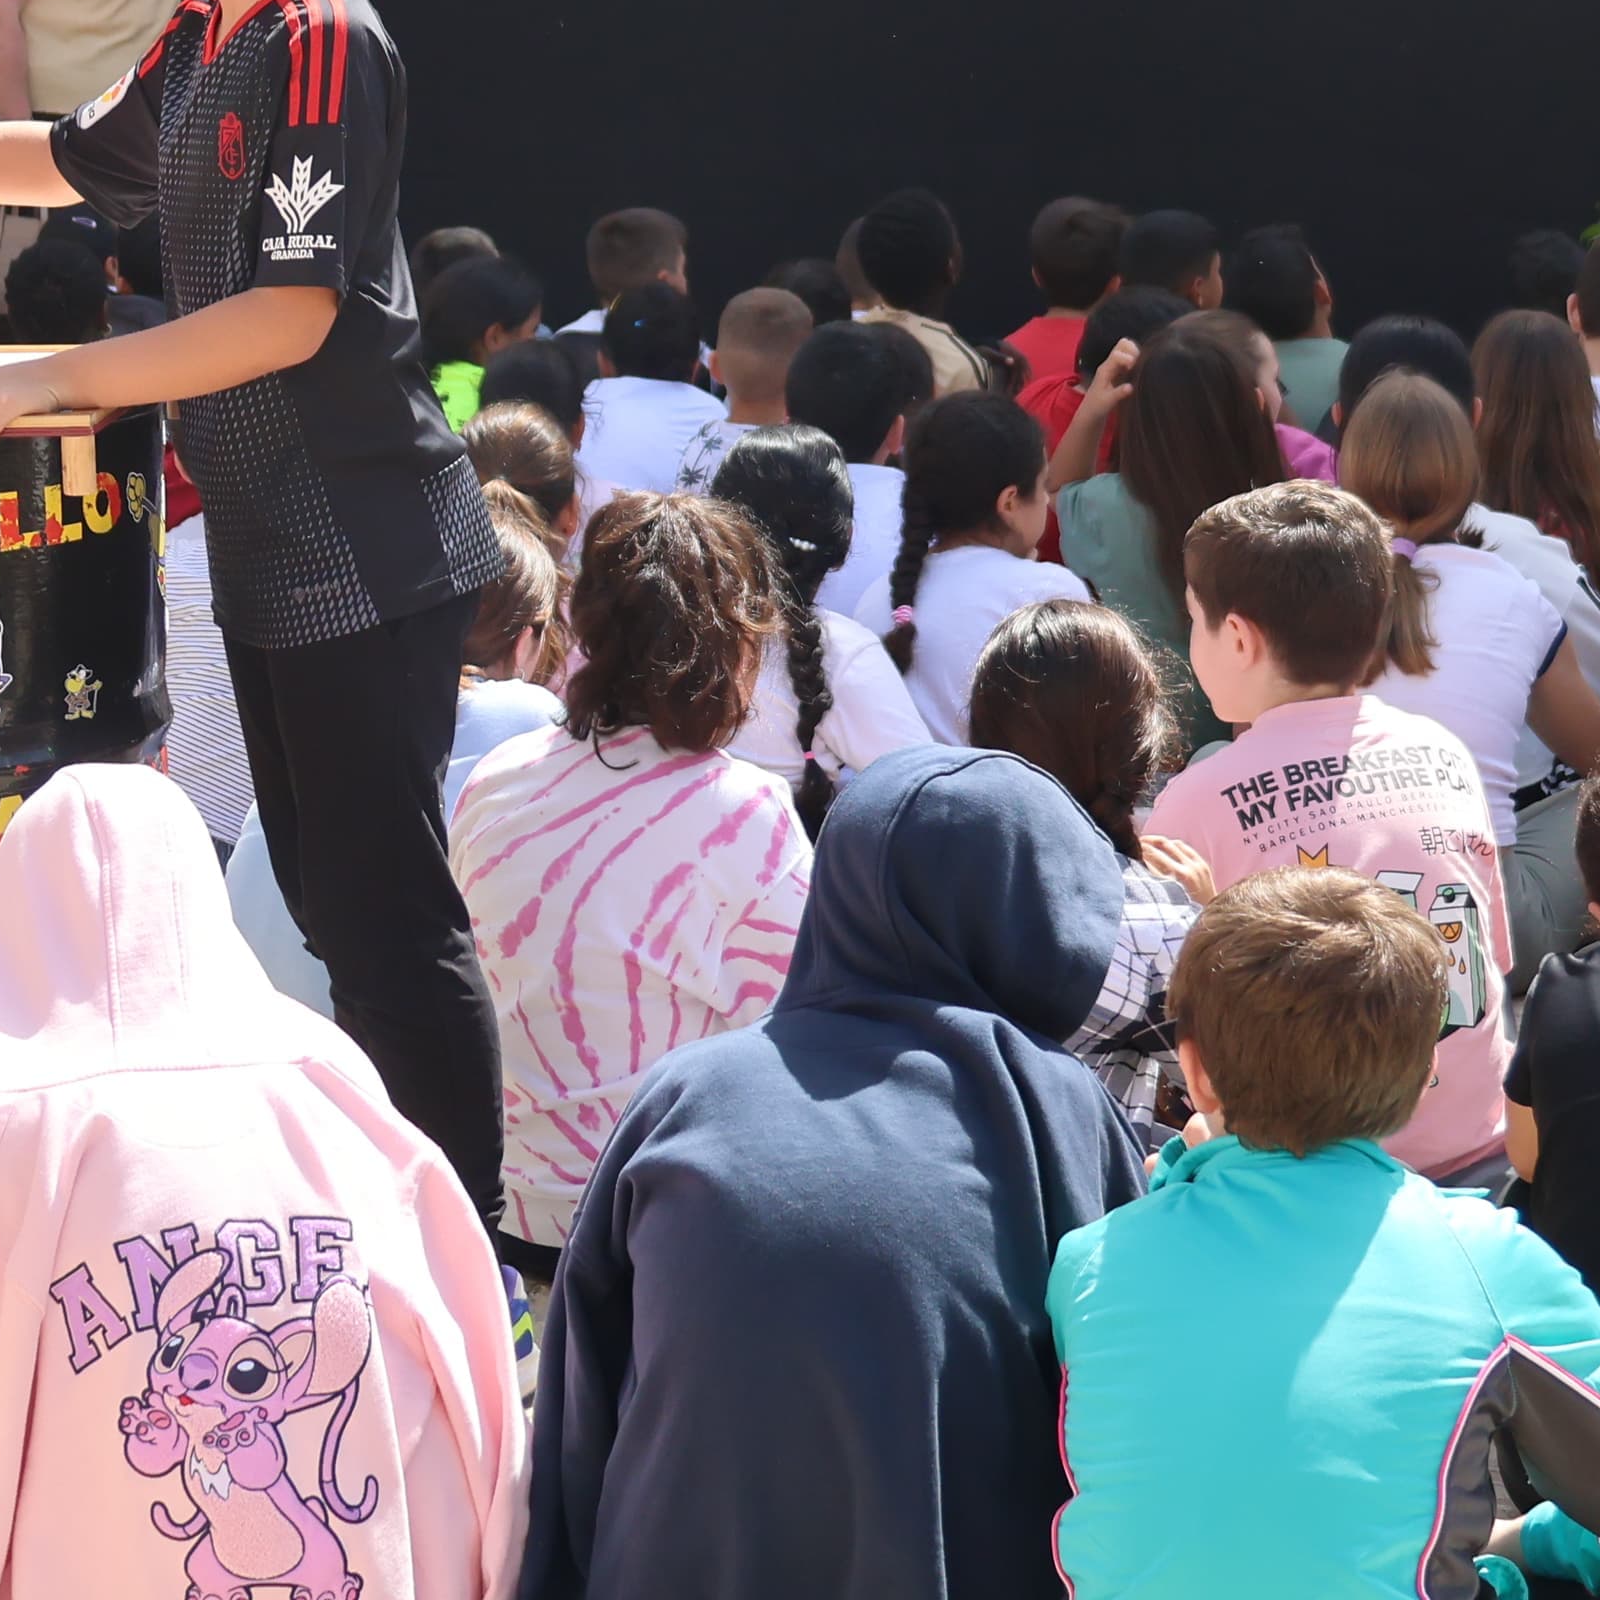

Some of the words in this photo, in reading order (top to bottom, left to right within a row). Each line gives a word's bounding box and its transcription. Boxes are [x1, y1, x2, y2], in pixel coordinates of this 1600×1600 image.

[262, 236, 286, 252] CAJA
[287, 234, 337, 250] RURAL
[270, 249, 315, 260] GRANADA
[1220, 771, 1279, 809] THE
[1283, 746, 1433, 787] BREAKFAST
[1236, 795, 1277, 831] MY
[1284, 768, 1433, 812] FAVOUTIRE
[1243, 832, 1259, 845] NY
[1267, 817, 1300, 834] CITY
[1308, 805, 1337, 820] SAO
[1346, 795, 1392, 810] PAULO
[1259, 817, 1347, 853] BARCELONA
